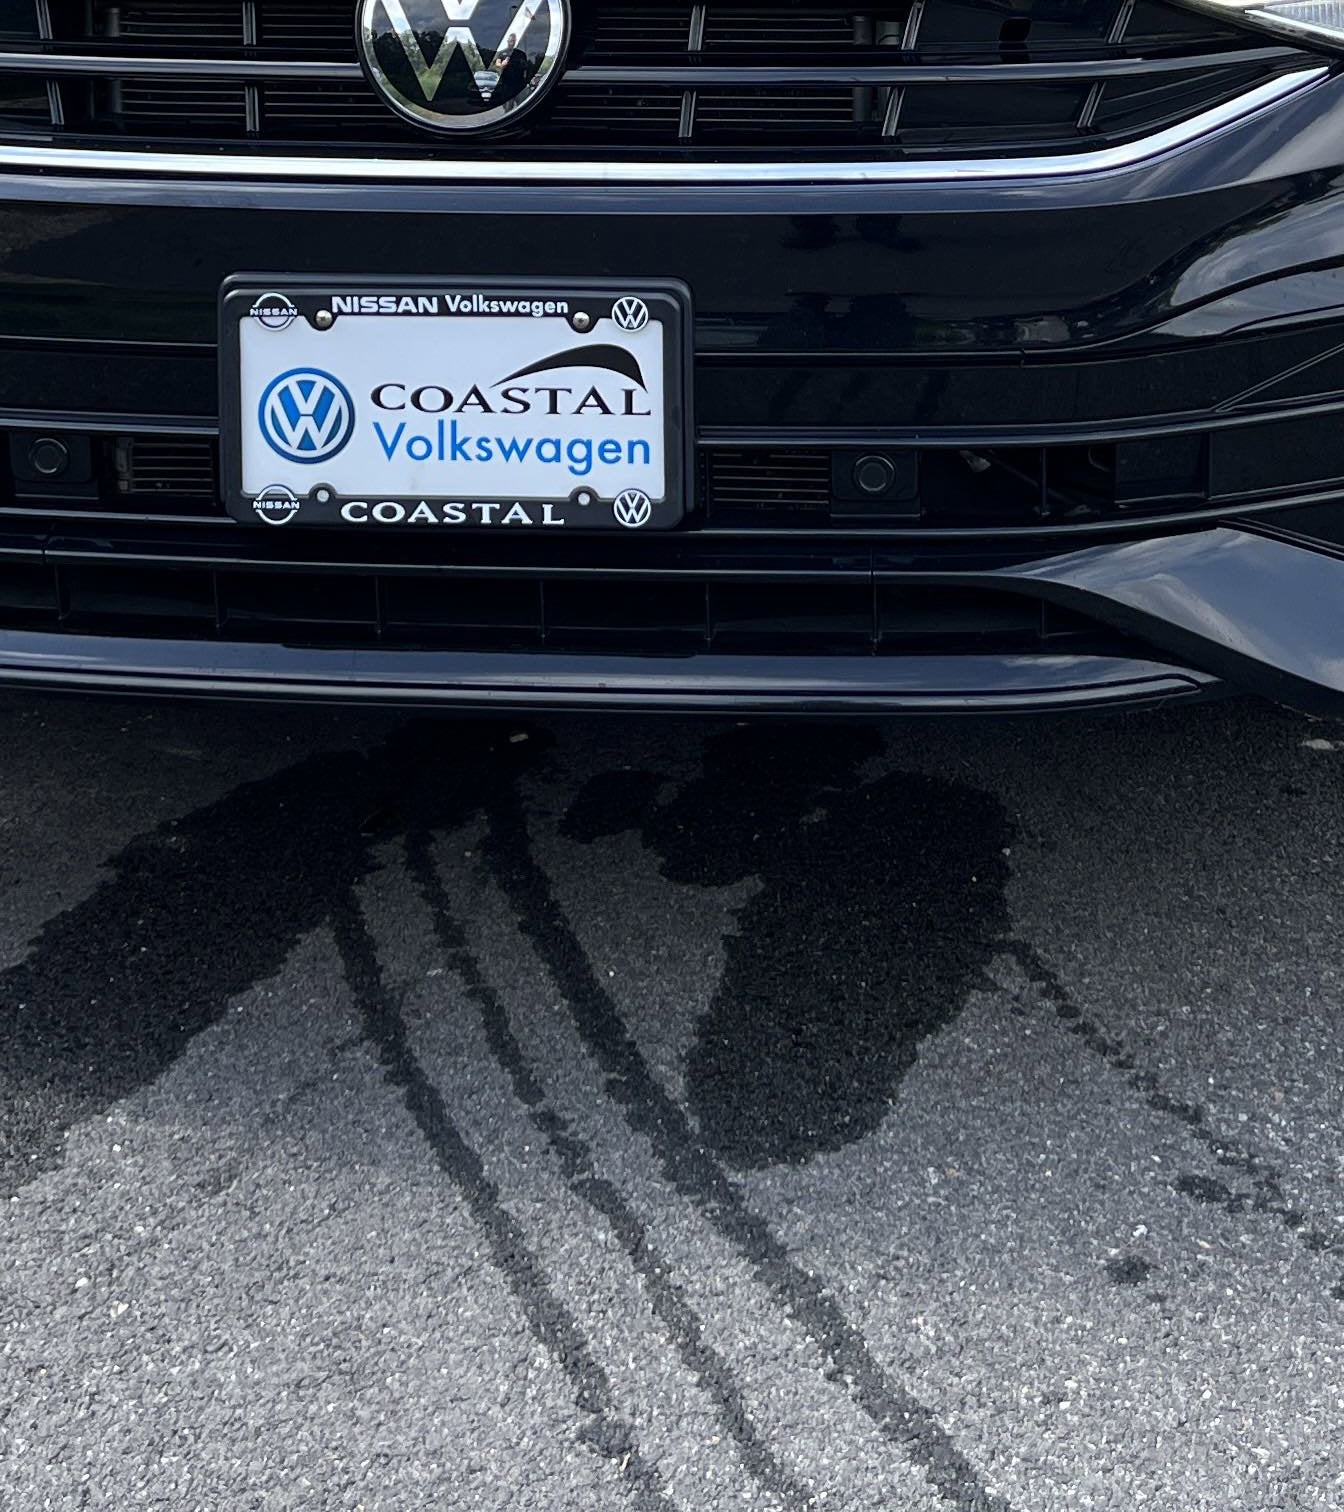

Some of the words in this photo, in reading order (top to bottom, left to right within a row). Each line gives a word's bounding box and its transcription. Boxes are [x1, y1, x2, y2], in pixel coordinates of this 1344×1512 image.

[249, 307, 298, 316] NISSAN
[331, 296, 439, 315] NISSAN
[444, 294, 569, 318] Volkswagen
[370, 383, 652, 417] COASTAL
[372, 419, 651, 476] Volkswagen
[252, 500, 300, 509] NISSAN
[340, 501, 565, 526] COASTAL
